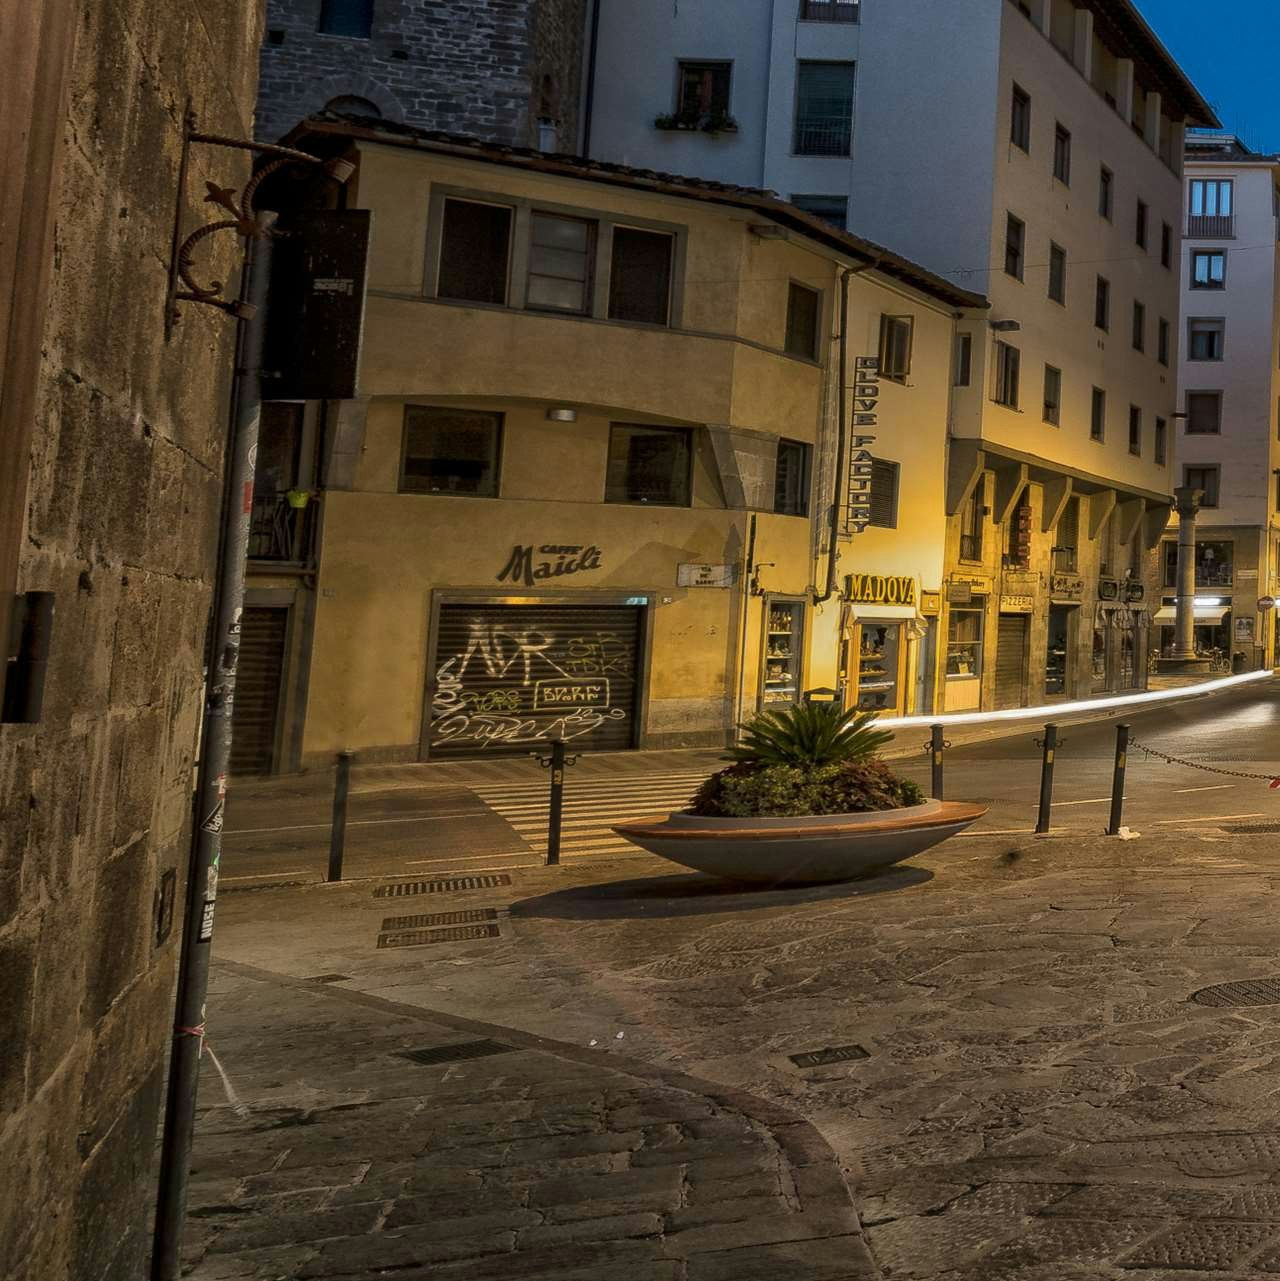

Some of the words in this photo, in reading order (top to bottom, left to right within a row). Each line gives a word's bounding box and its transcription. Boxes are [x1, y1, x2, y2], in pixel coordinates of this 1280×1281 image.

[853, 356, 879, 426] GLOVE
[847, 435, 877, 534] FACTORY
[849, 574, 917, 604] MADOVA
[201, 903, 216, 940] NOSE
